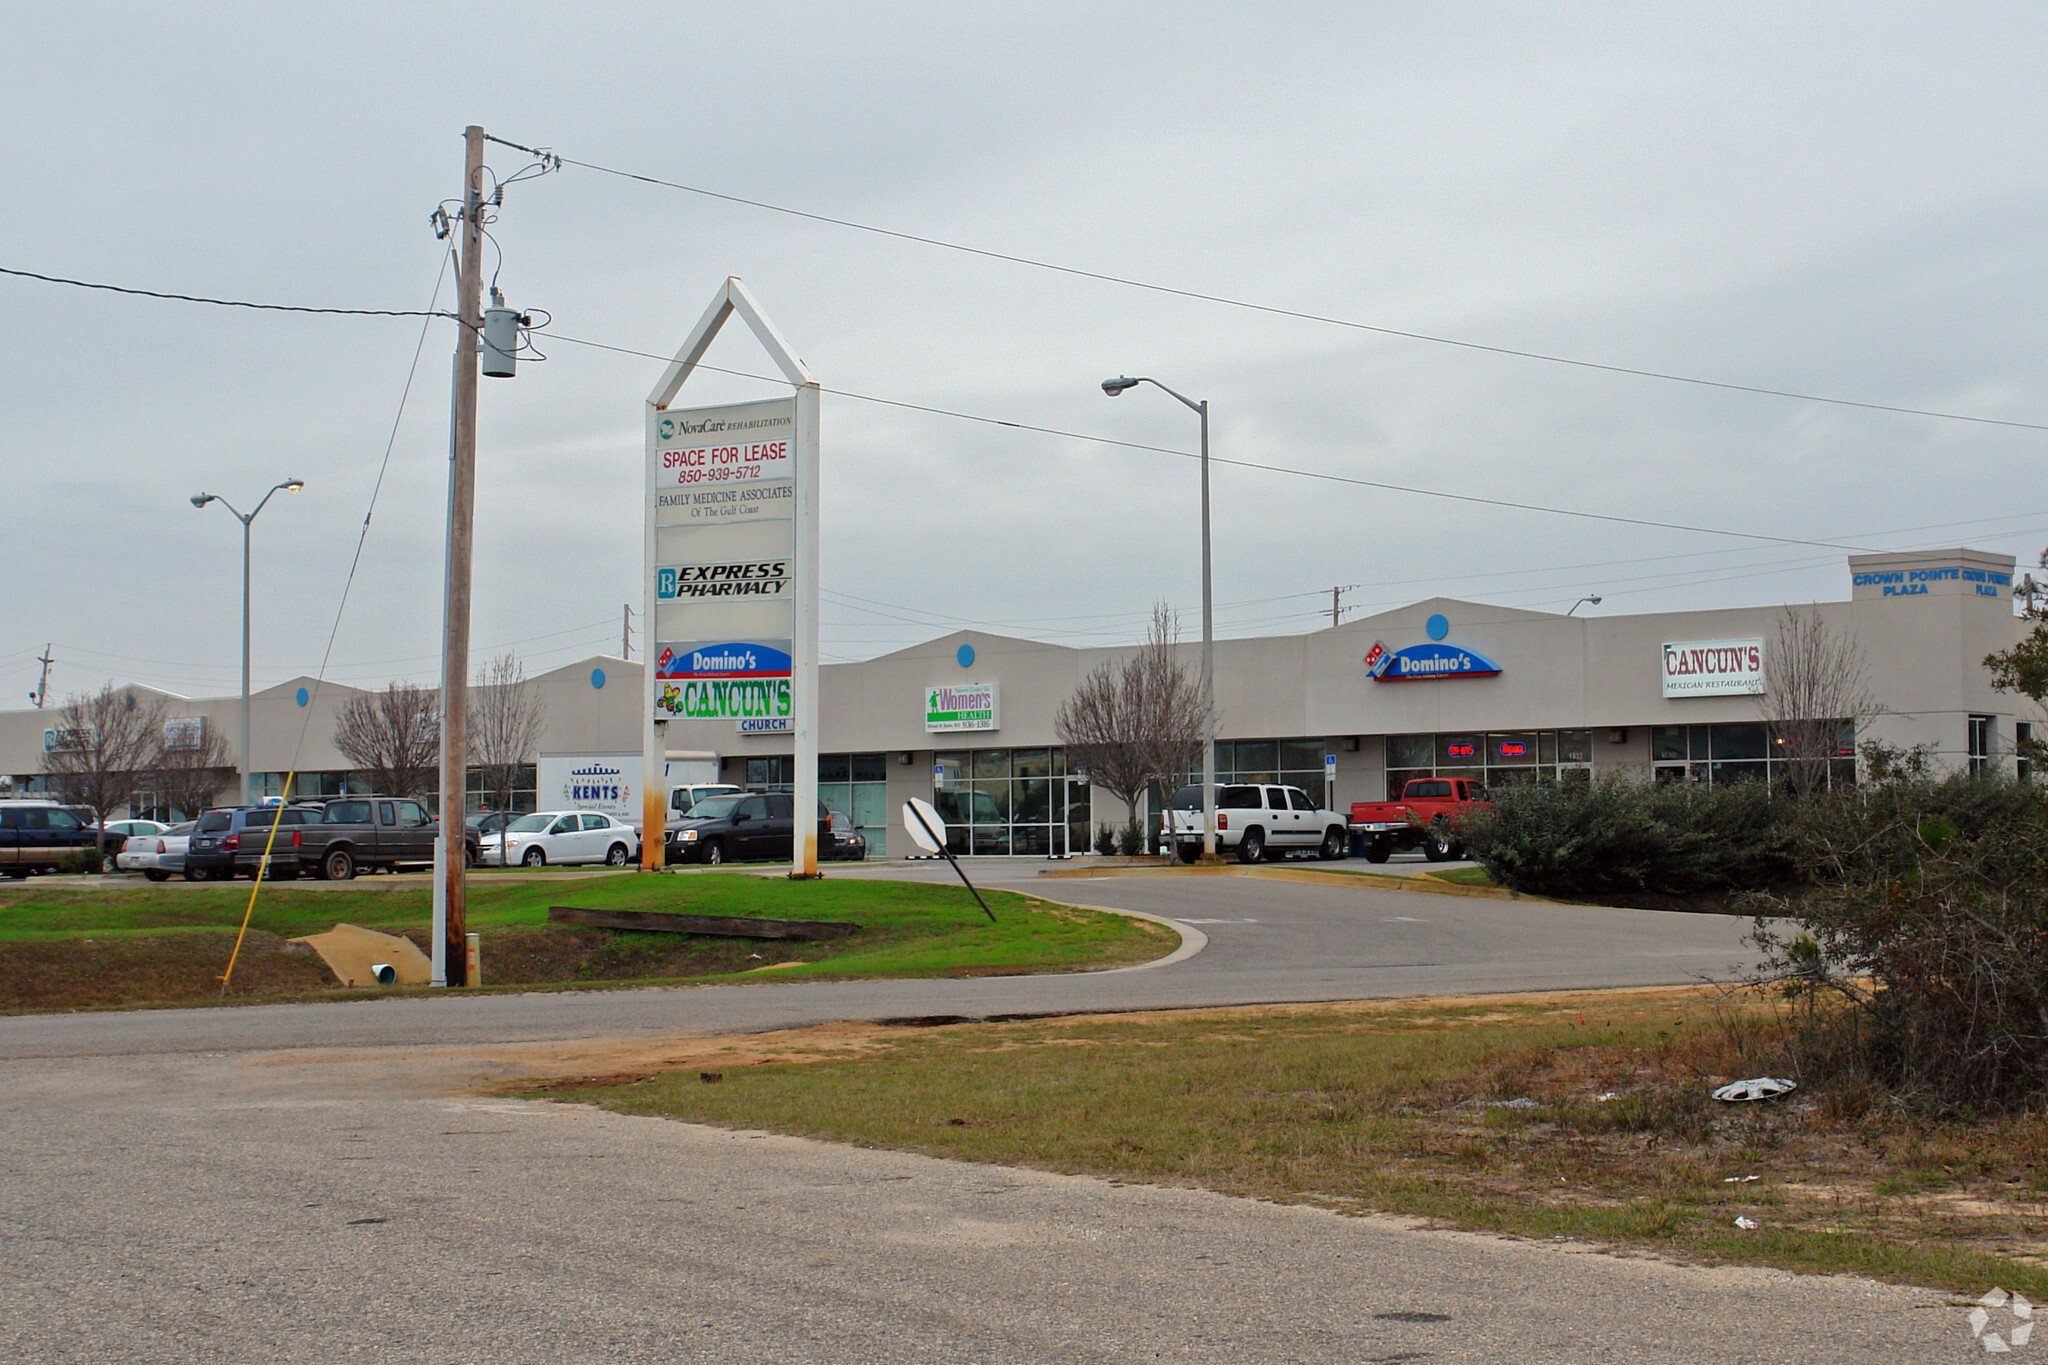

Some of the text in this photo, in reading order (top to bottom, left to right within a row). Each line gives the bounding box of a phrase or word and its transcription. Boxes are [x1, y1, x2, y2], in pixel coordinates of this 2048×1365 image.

[678, 417, 792, 435] NovaCare REHABILITATION
[664, 442, 786, 468] SPACE FOR LEASE
[678, 464, 760, 484] 850-939-5712
[659, 486, 792, 506] FAMILY MEDICINE ASSOCIATES
[691, 504, 758, 518] Of The Gulf Coast
[678, 562, 786, 581] EXPRESS
[1853, 568, 1960, 586] CROWN POINTE
[677, 580, 787, 597] PHARMACY
[1883, 584, 1928, 596] PLAZA
[1976, 584, 1998, 596] PLAZA
[693, 650, 756, 670] Domino's
[1400, 653, 1471, 672] Domino's
[1666, 646, 1760, 676] CANCUN'S
[1706, 680, 1760, 688] RESTAURANT
[684, 679, 790, 717] CANCUN'S
[939, 688, 990, 710] Women's
[958, 710, 990, 720] HEALTH
[742, 720, 786, 730] CHURCH
[573, 786, 618, 800] KENTS
